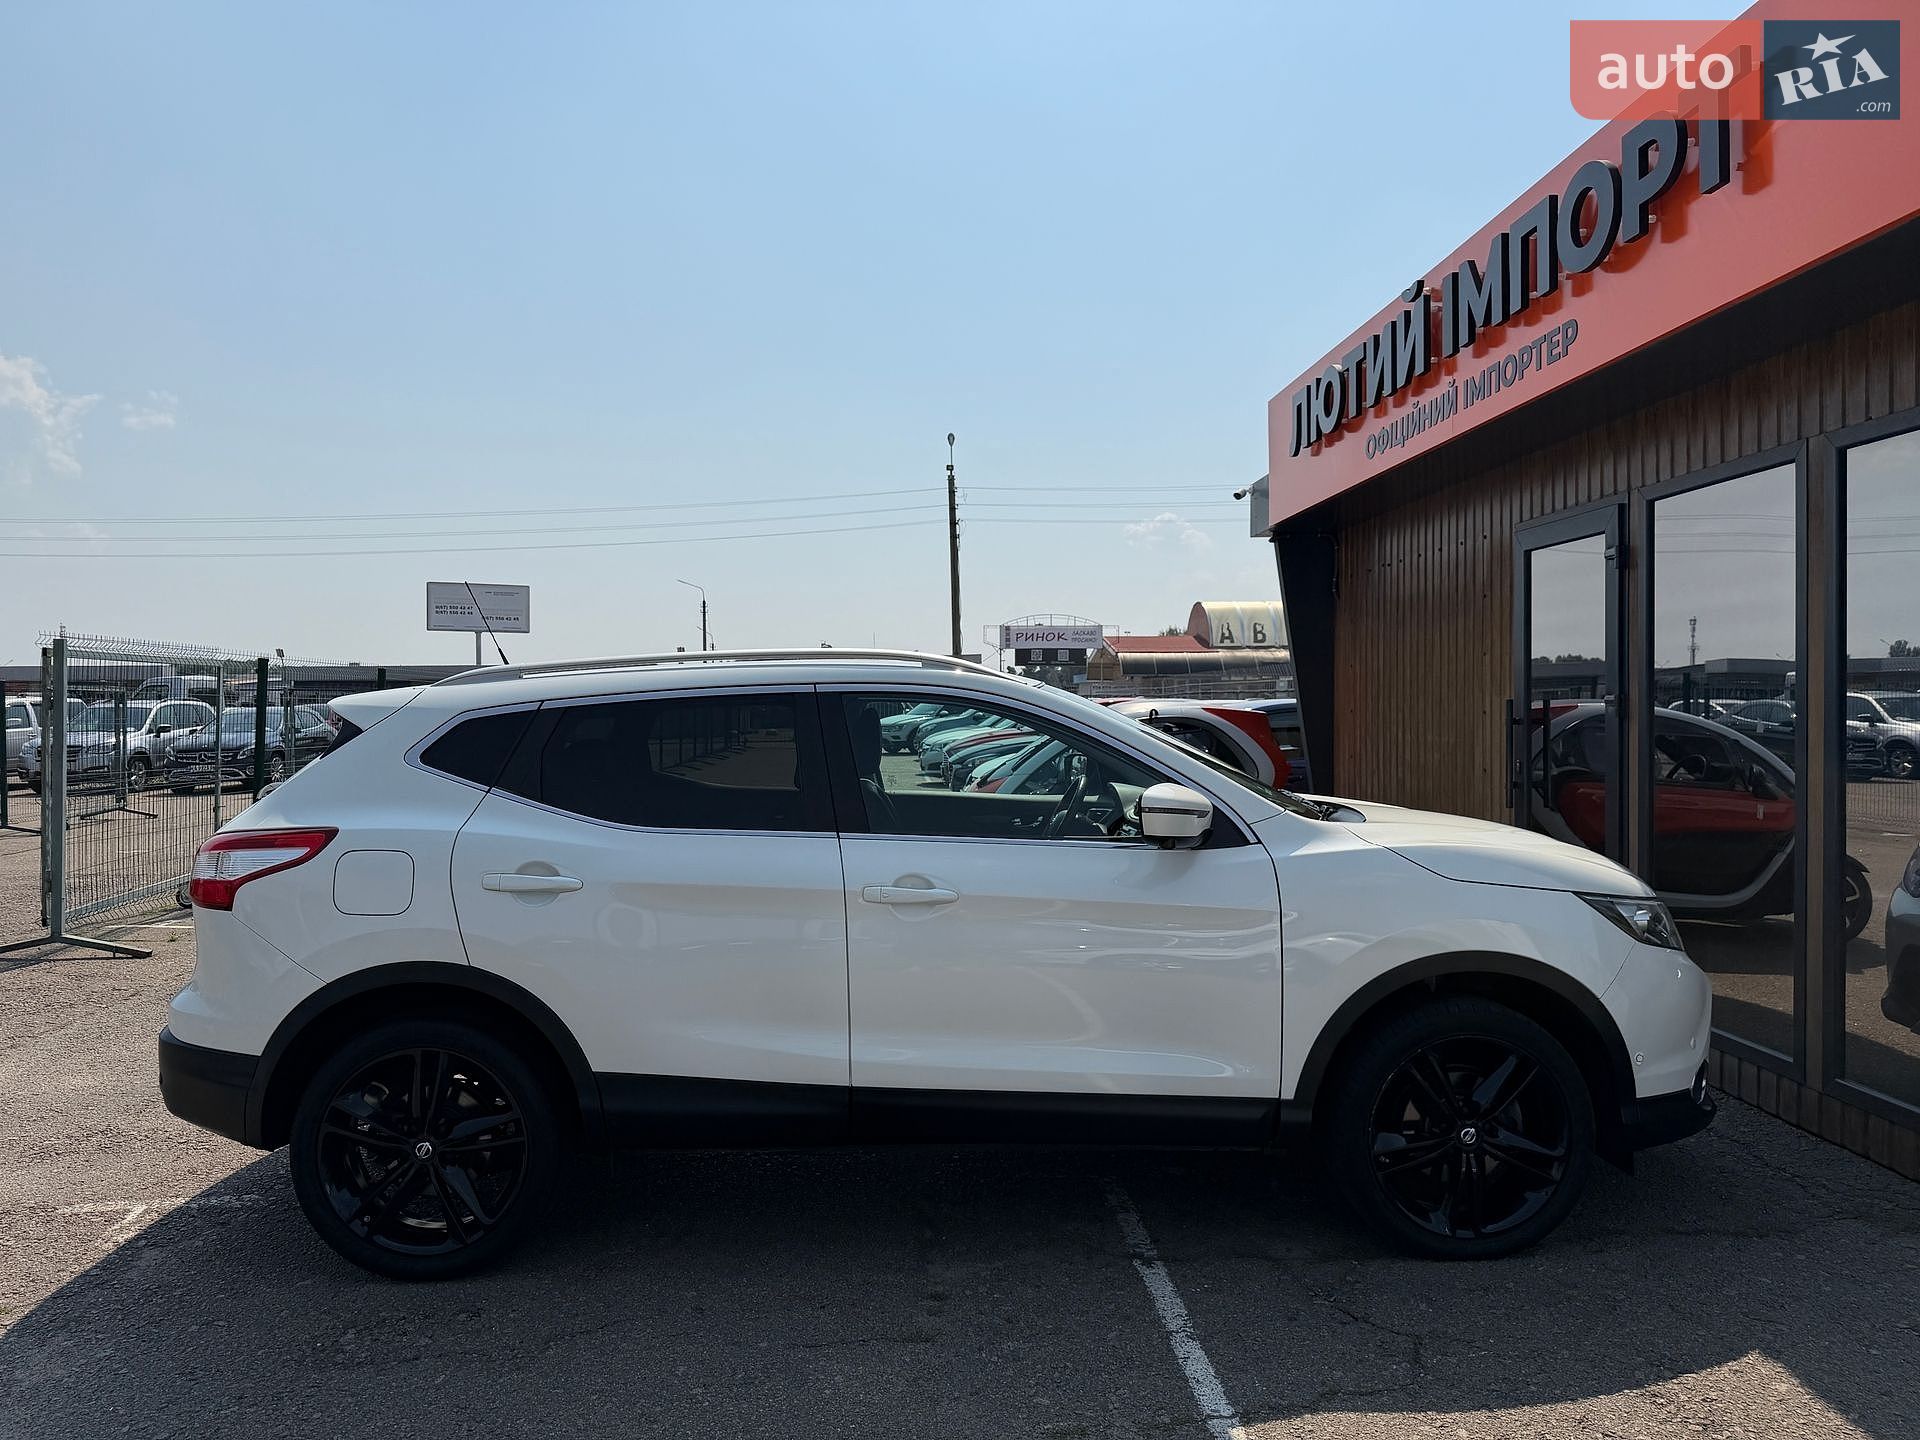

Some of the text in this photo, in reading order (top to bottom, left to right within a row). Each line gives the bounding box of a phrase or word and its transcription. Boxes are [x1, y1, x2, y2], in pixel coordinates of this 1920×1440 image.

[1288, 279, 1432, 458] ЛЮТИЙ
[1364, 317, 1580, 461] ОФІЦІЙНИЙ ІМПОРТЕР
[1015, 631, 1068, 642] РИНОК
